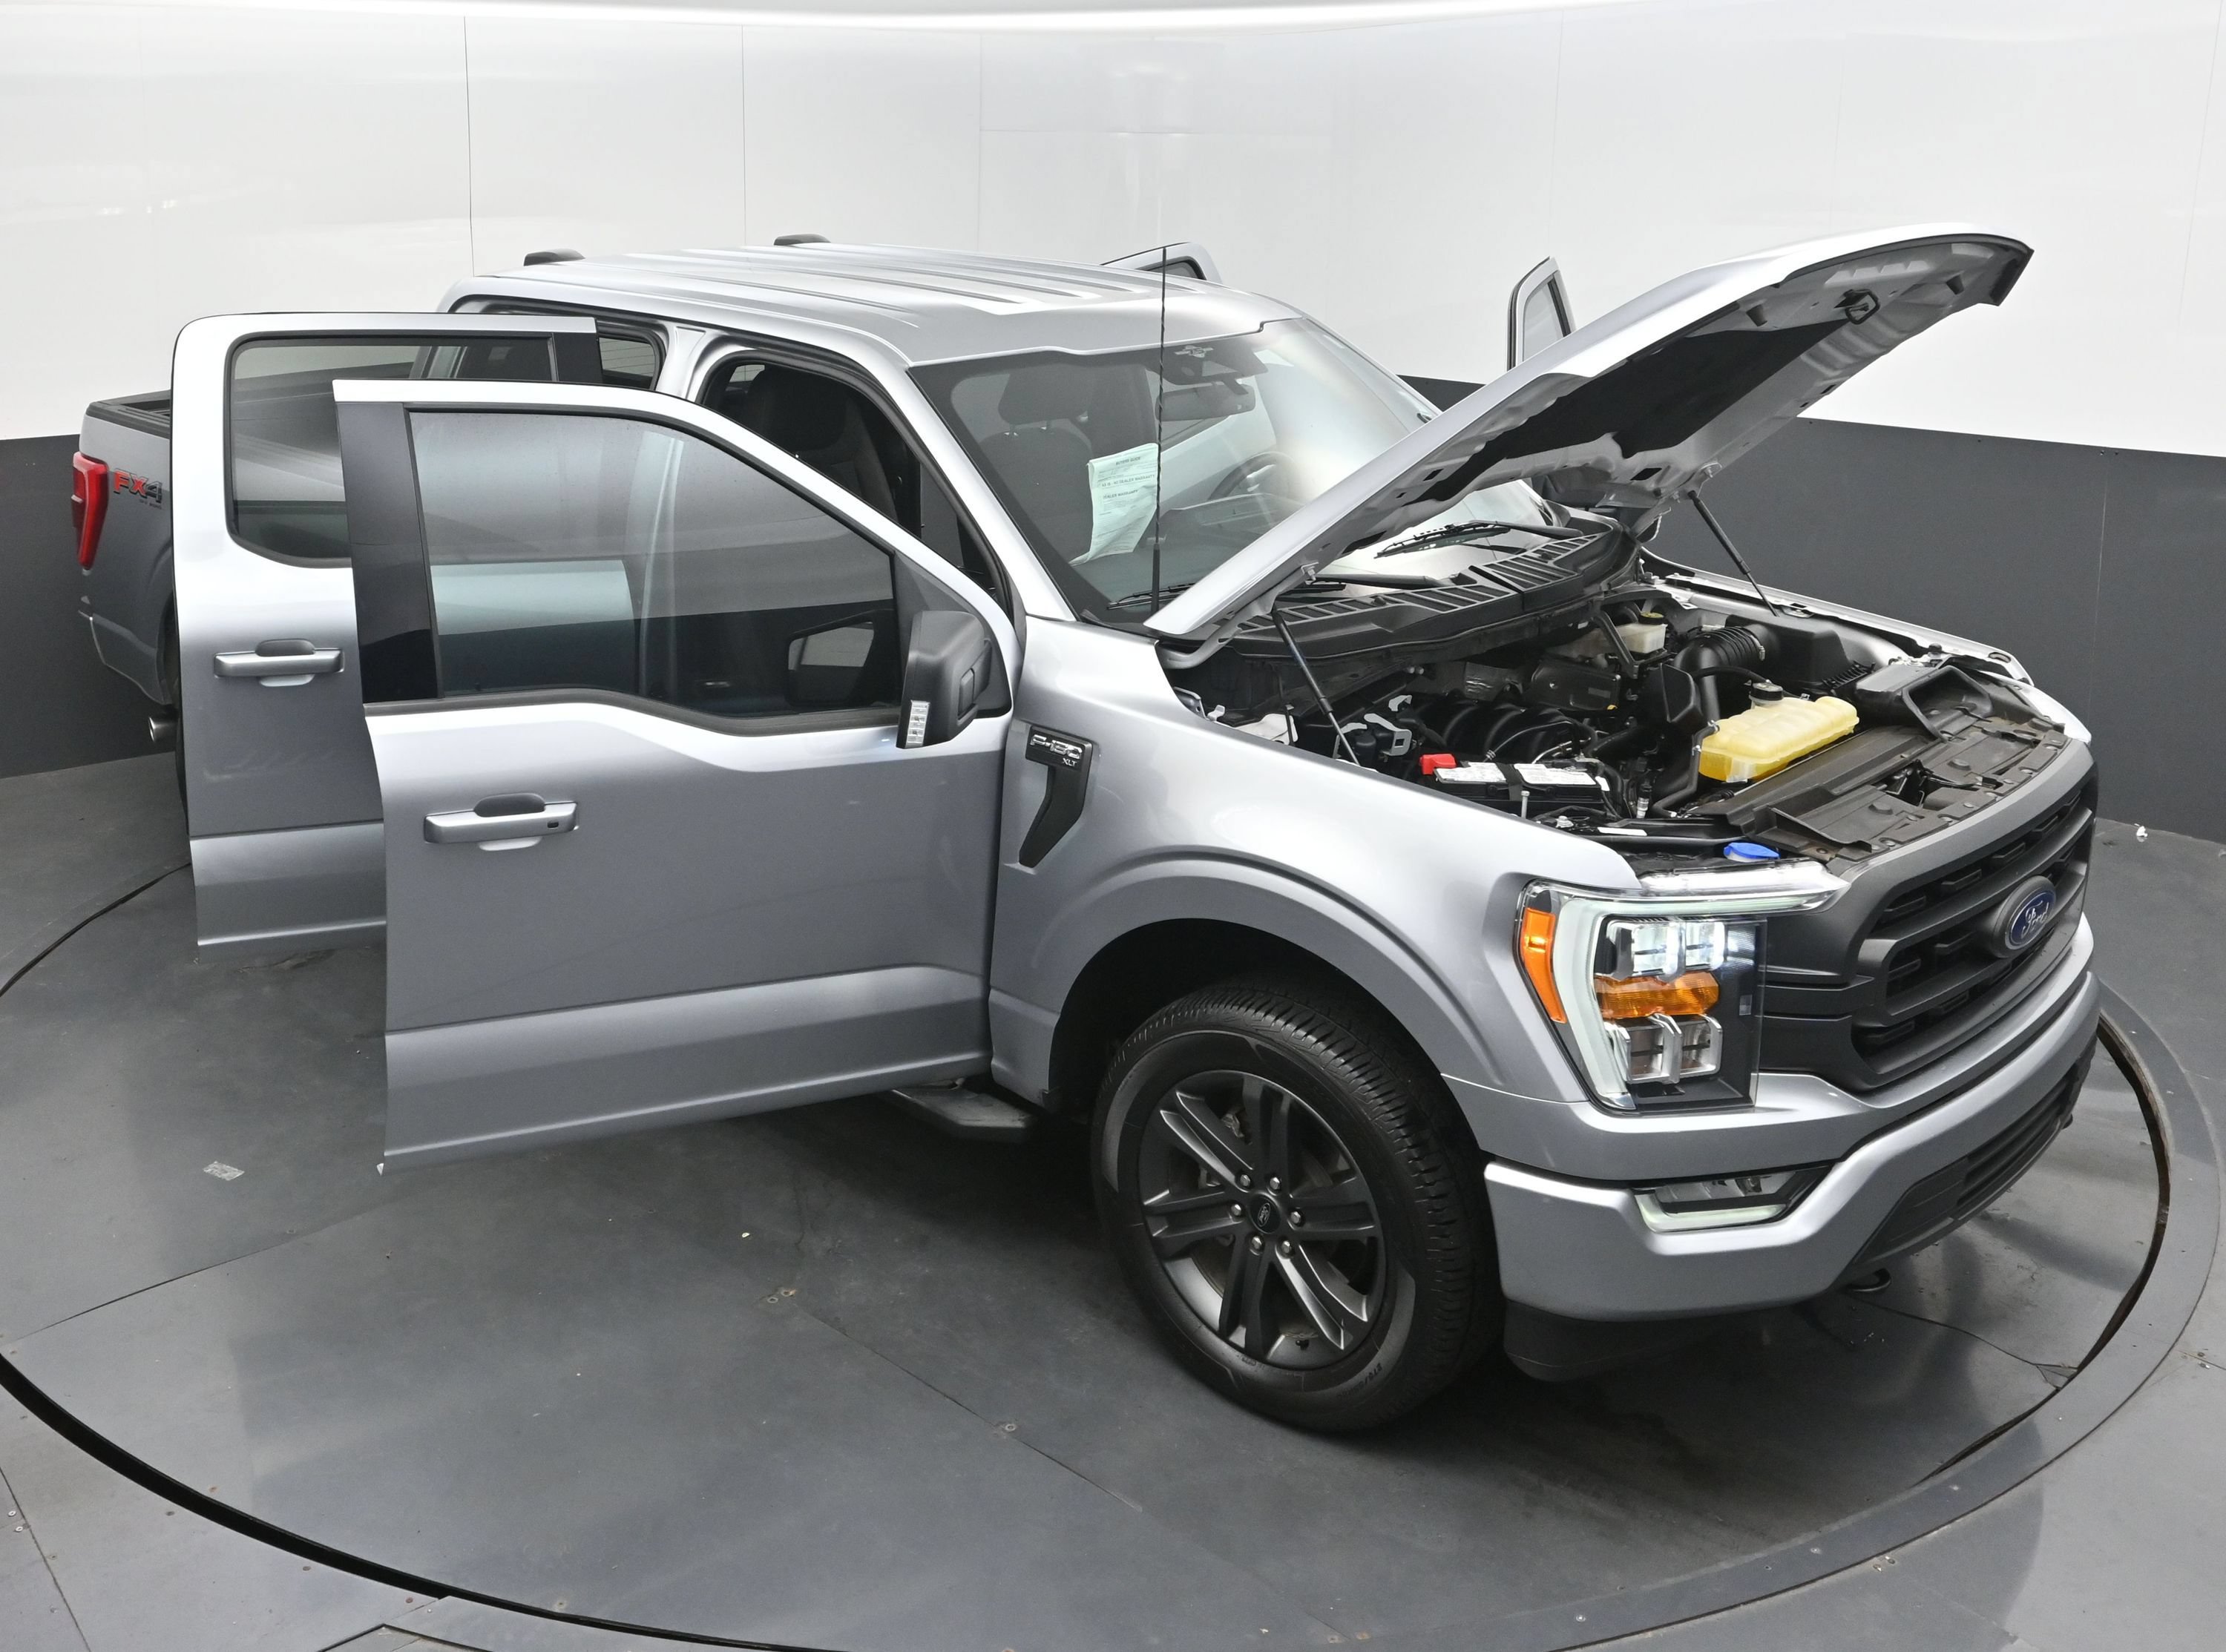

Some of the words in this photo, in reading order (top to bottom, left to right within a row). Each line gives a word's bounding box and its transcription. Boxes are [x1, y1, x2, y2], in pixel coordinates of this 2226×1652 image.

[113, 467, 163, 504] FX4
[1030, 733, 1084, 760] F-150
[1062, 757, 1078, 768] XLT
[2020, 899, 2050, 940] Ford
